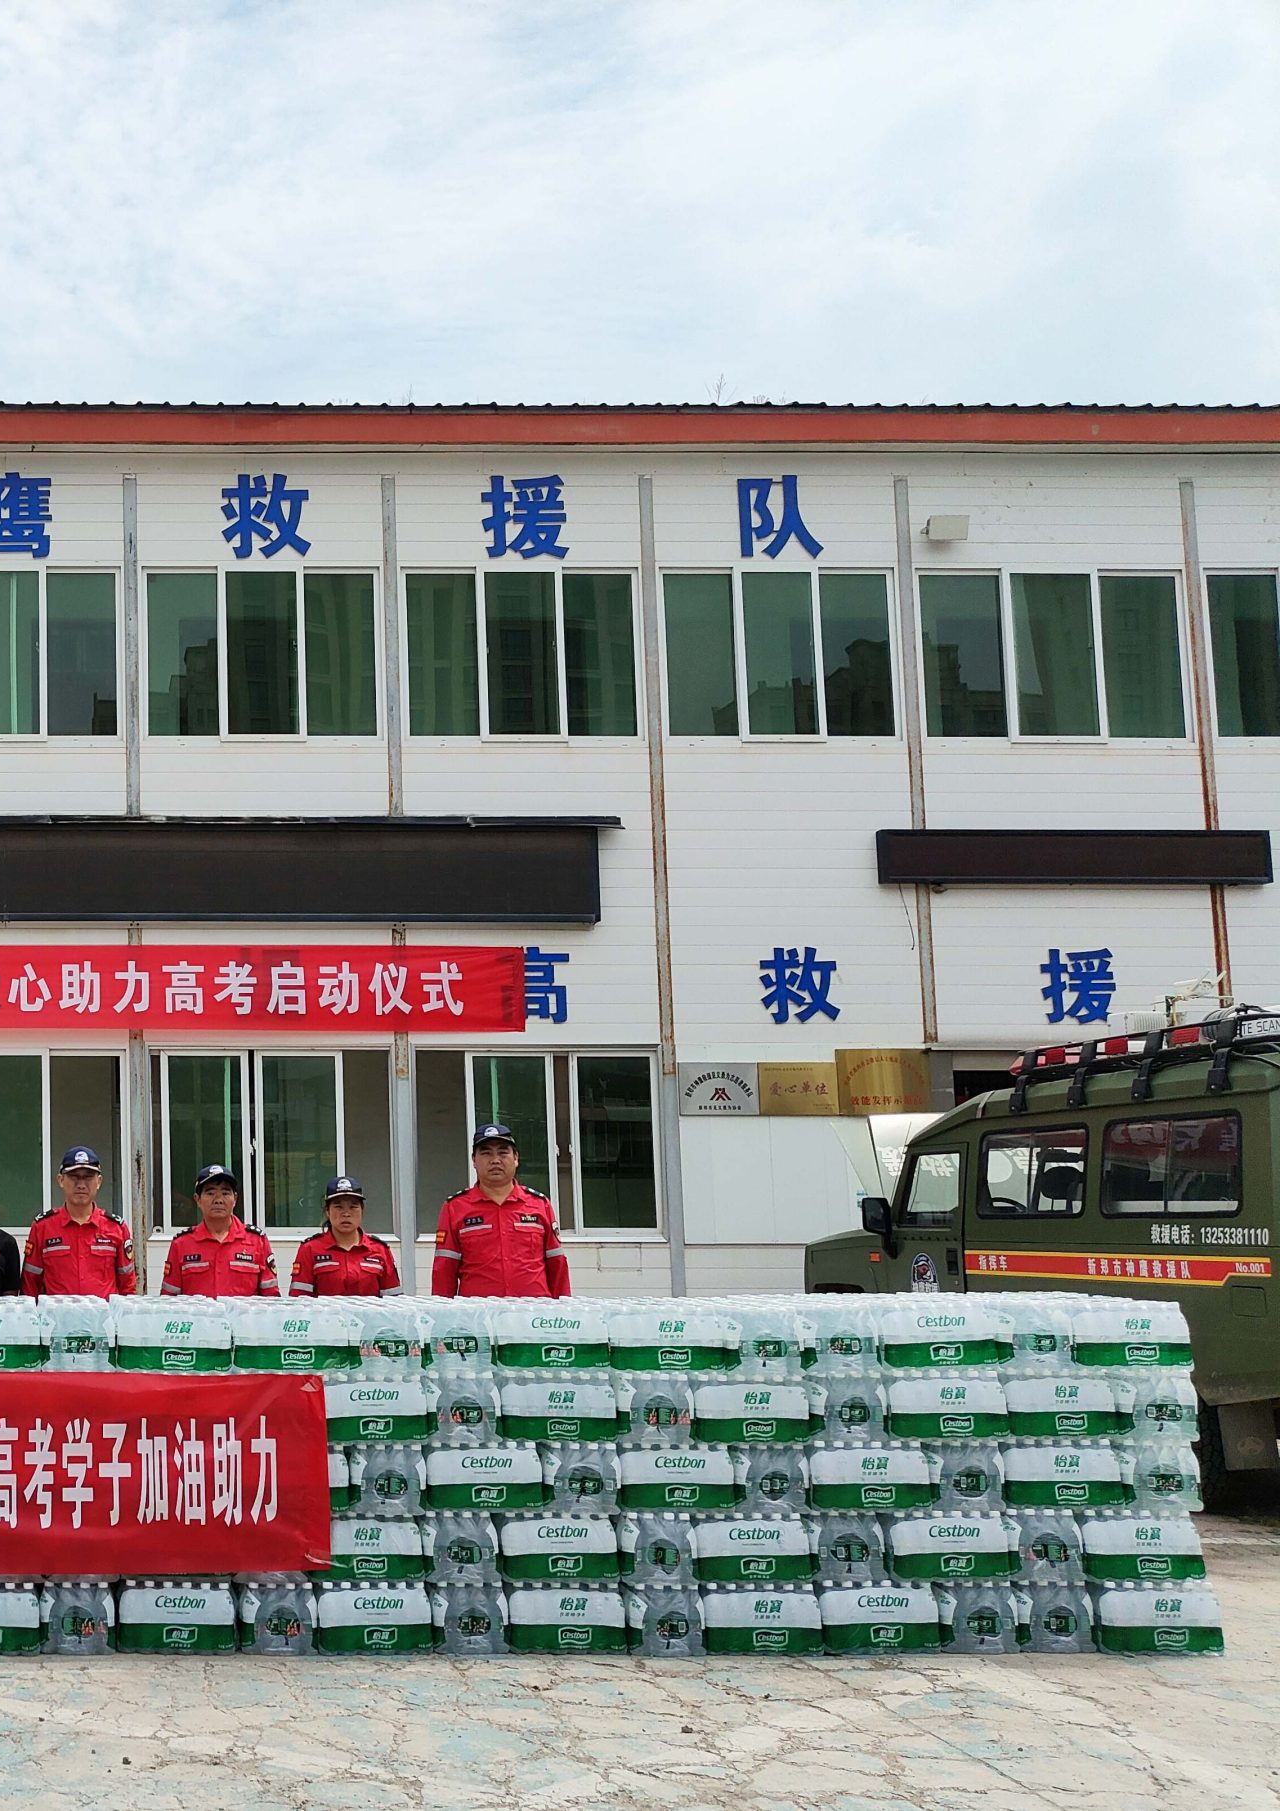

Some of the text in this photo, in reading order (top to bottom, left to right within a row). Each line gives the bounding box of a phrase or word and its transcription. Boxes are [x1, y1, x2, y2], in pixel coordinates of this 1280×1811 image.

[769, 1081, 829, 1096] 爱心单位
[1200, 1227, 1269, 1246] 13253381110
[978, 1255, 1008, 1271] 指挥车
[1087, 1258, 1191, 1279] 新郑市神鹰救援队
[1236, 1263, 1265, 1274] No.001
